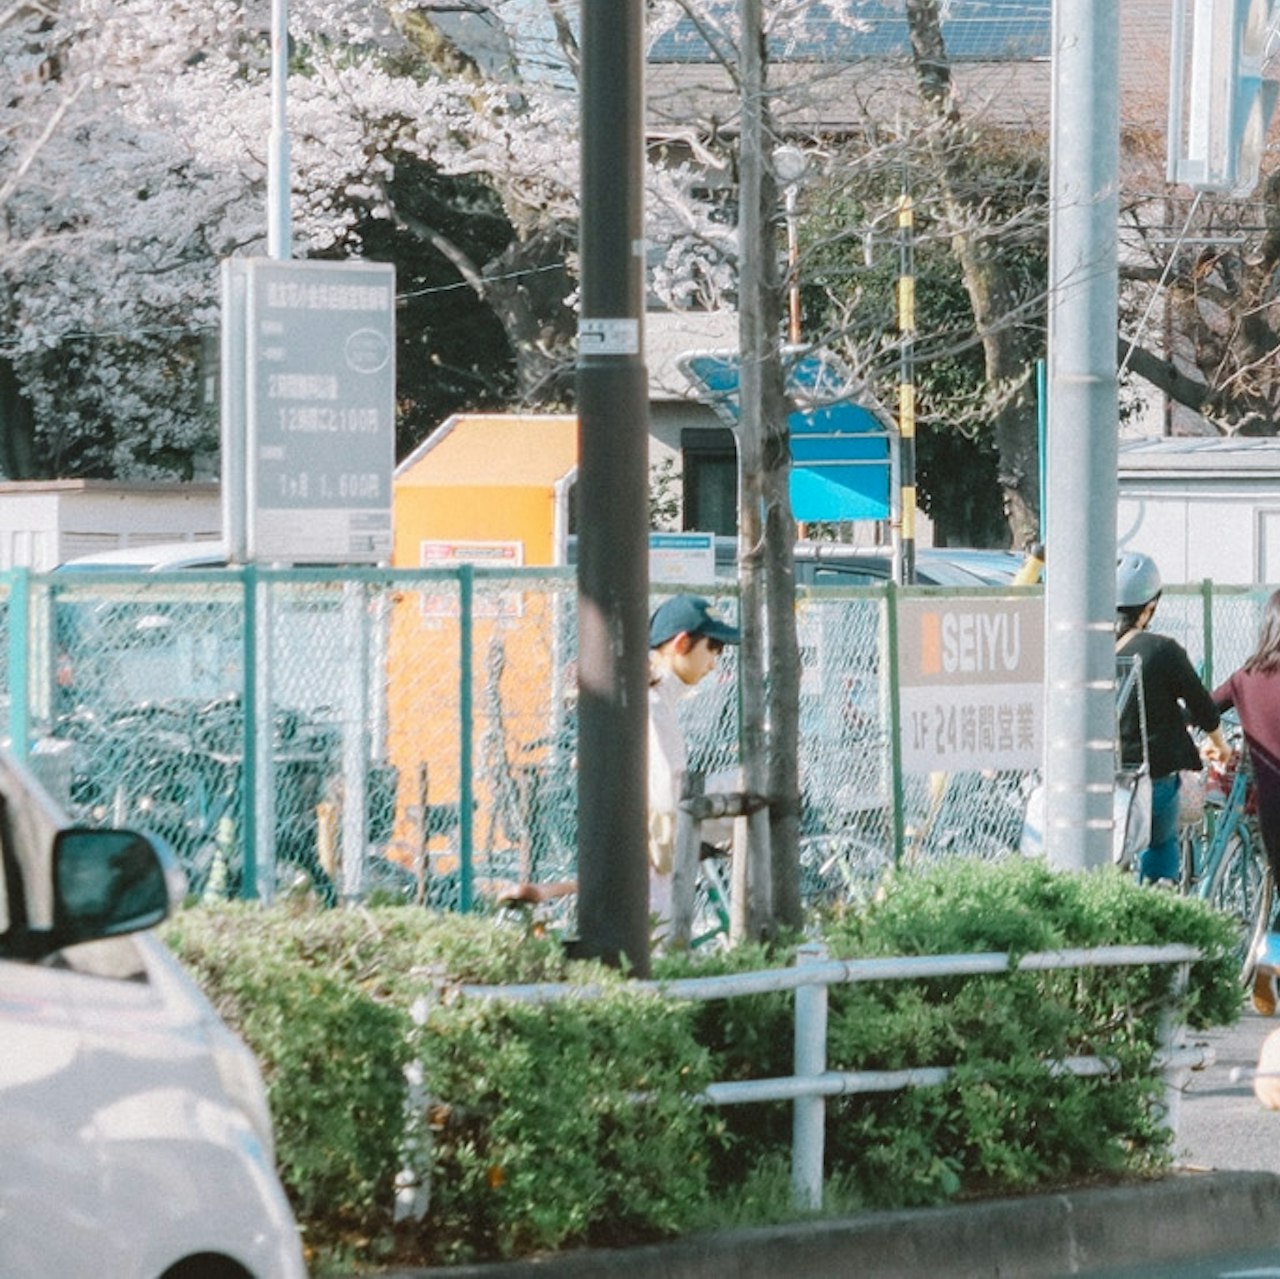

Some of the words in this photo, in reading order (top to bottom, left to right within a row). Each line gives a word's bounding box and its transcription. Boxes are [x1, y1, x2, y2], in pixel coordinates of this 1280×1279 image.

[941, 611, 1021, 674] SEIYU
[935, 703, 1035, 755] 24時間営業
